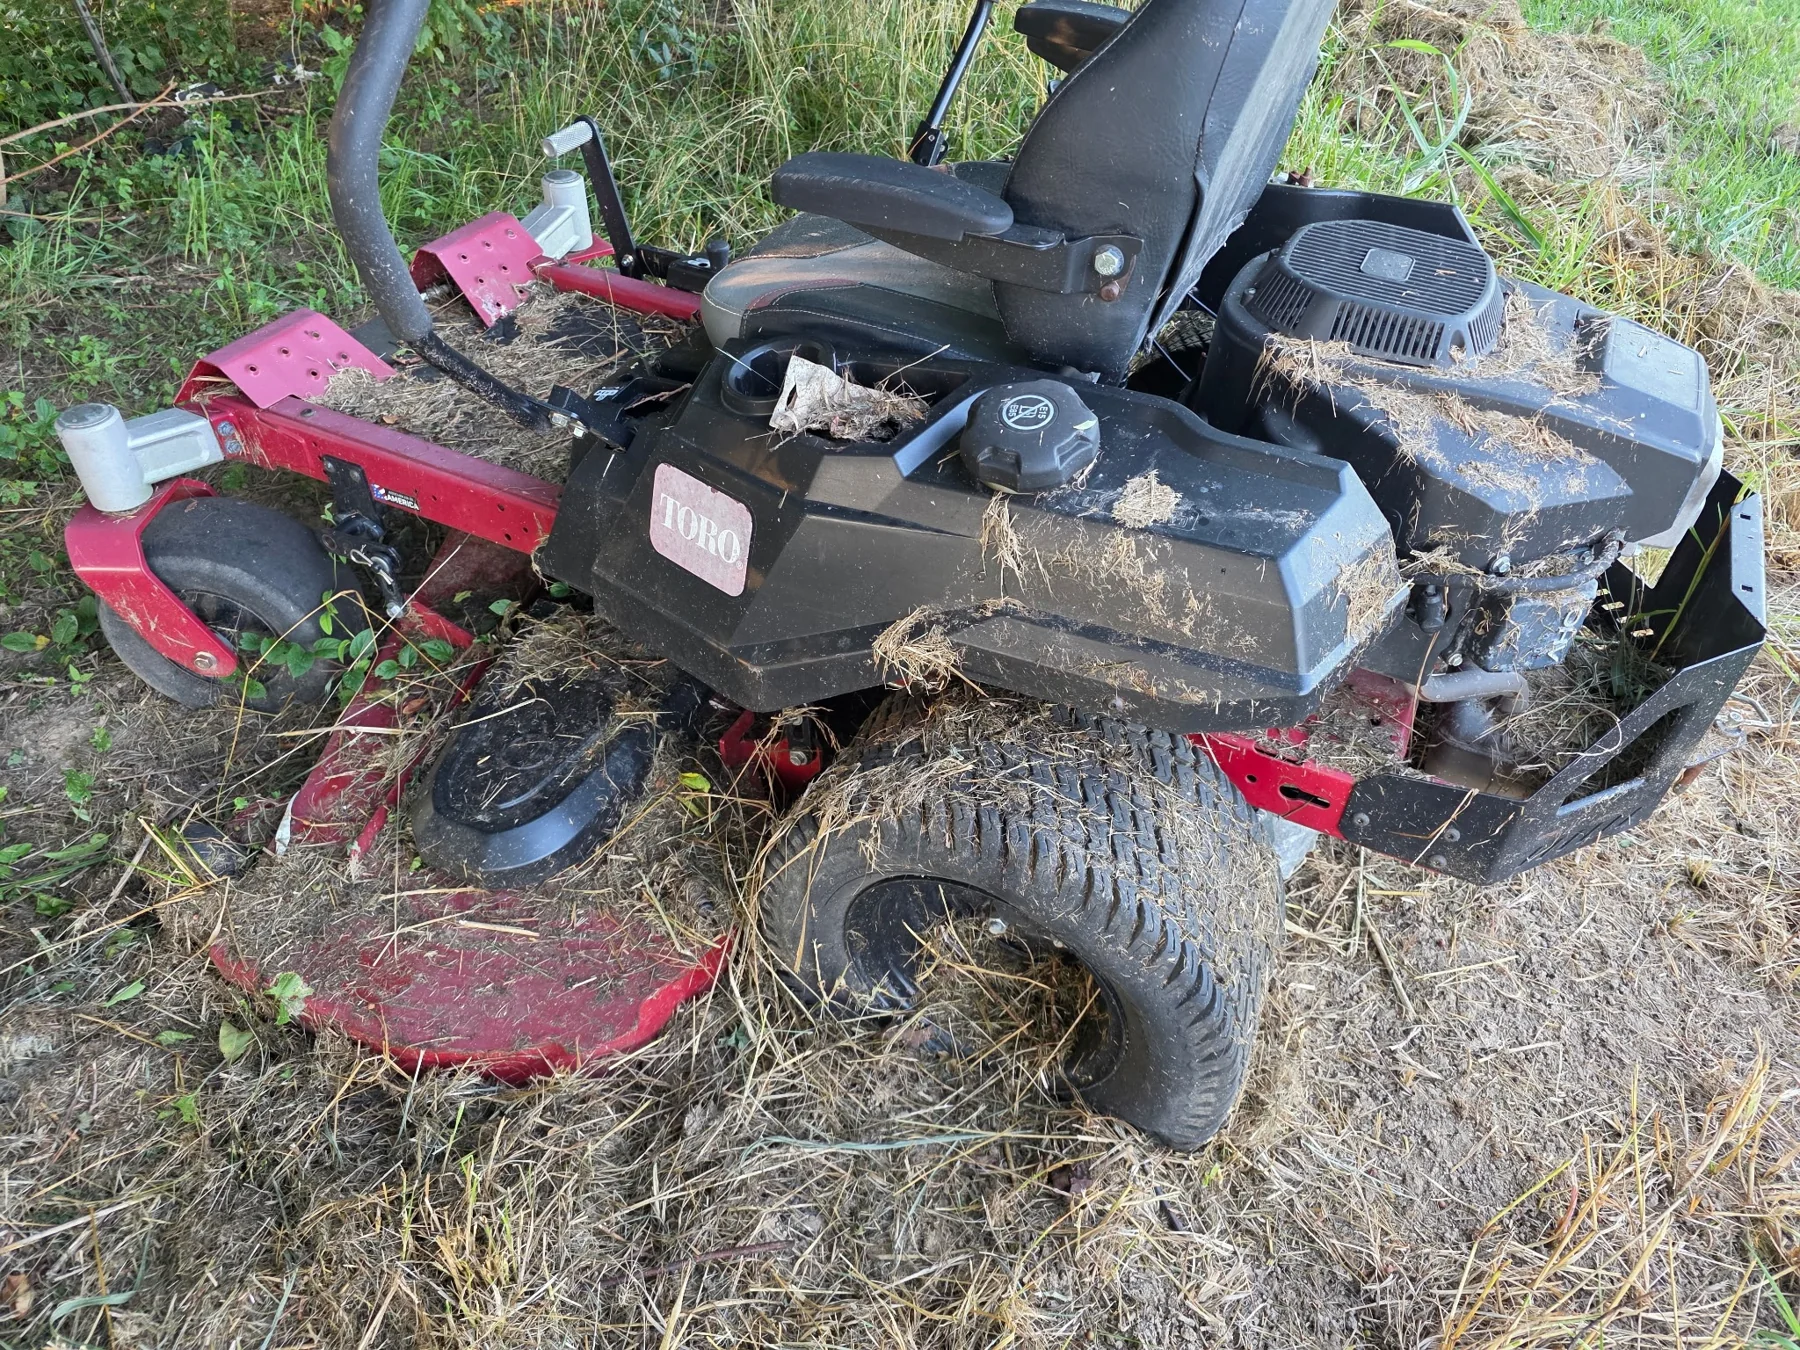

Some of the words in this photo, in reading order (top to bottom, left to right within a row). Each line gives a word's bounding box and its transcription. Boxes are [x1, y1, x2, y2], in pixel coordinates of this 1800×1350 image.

[1008, 404, 1019, 417] E85
[1037, 406, 1049, 419] E15
[385, 494, 420, 511] AMERICA
[1547, 607, 1582, 662] OHV
